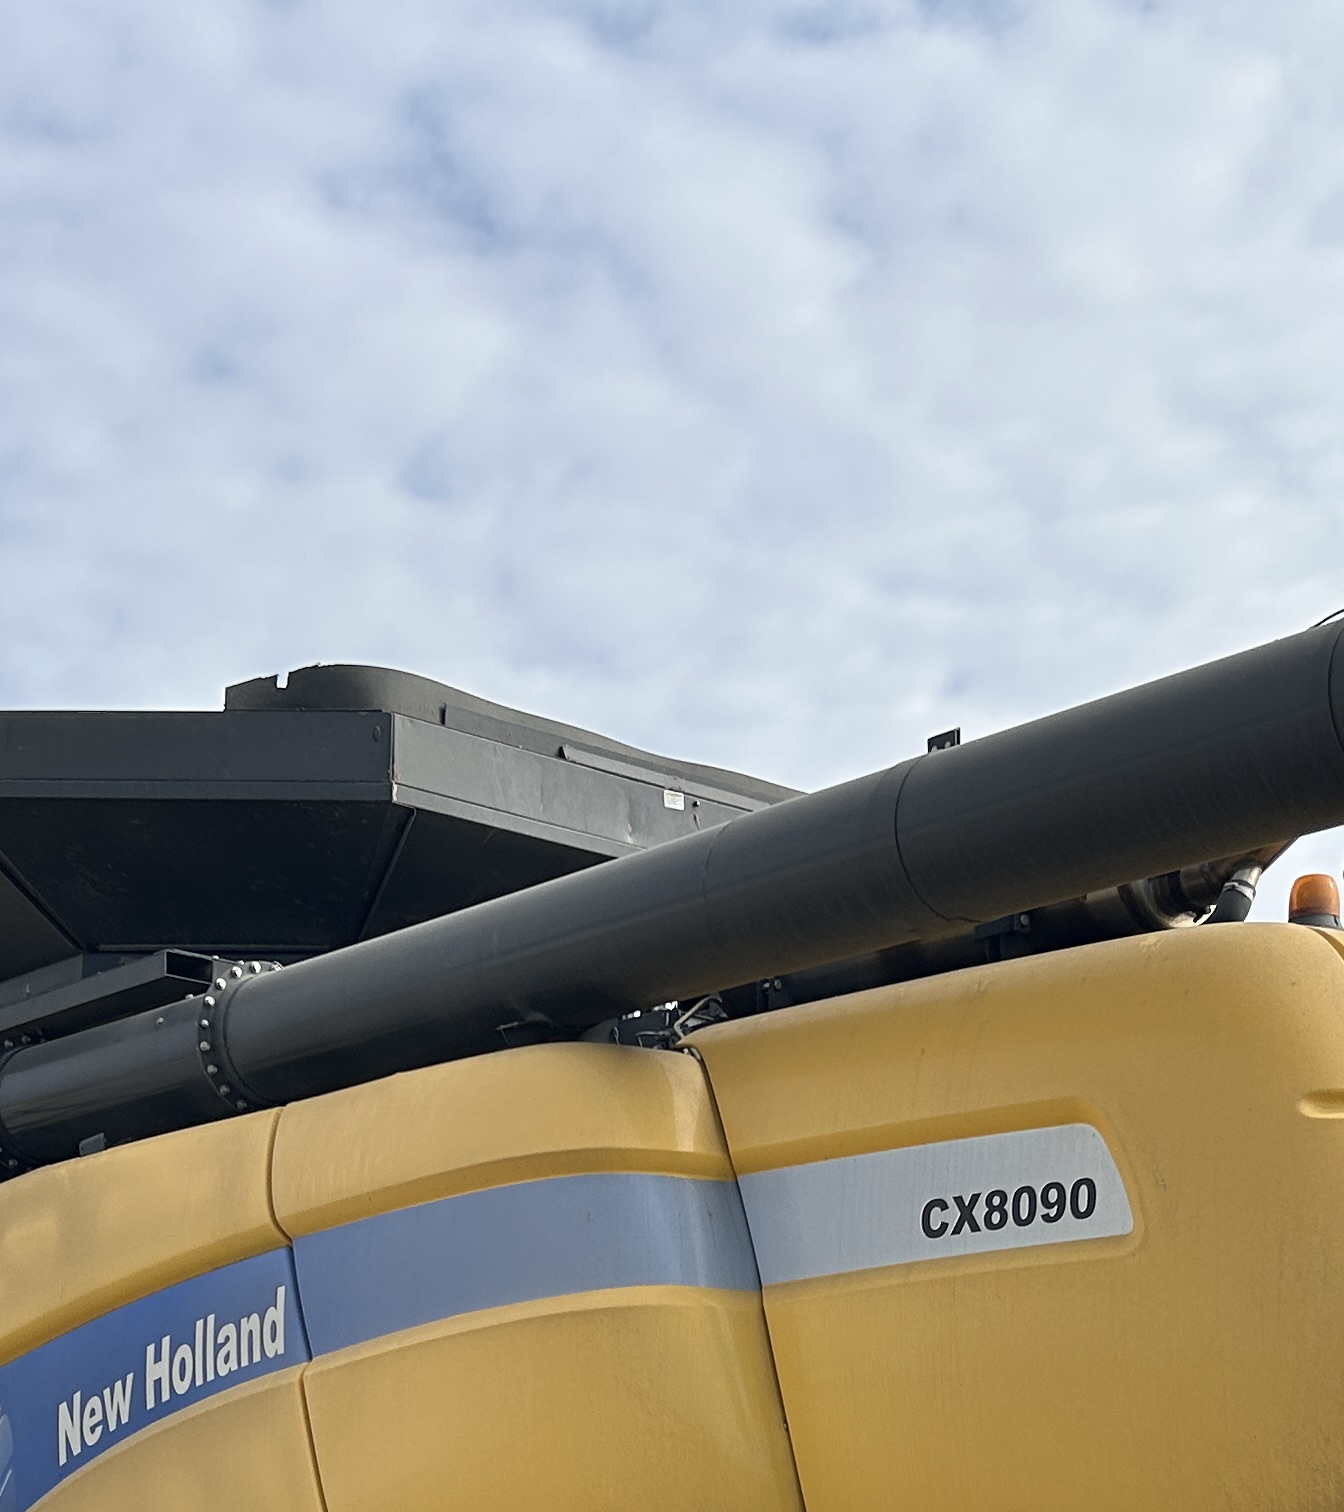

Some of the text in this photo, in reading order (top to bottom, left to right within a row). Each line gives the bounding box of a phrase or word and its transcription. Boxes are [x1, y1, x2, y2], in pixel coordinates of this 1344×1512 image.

[921, 1177, 1097, 1239] CX8090
[58, 1285, 286, 1467] New Holland
